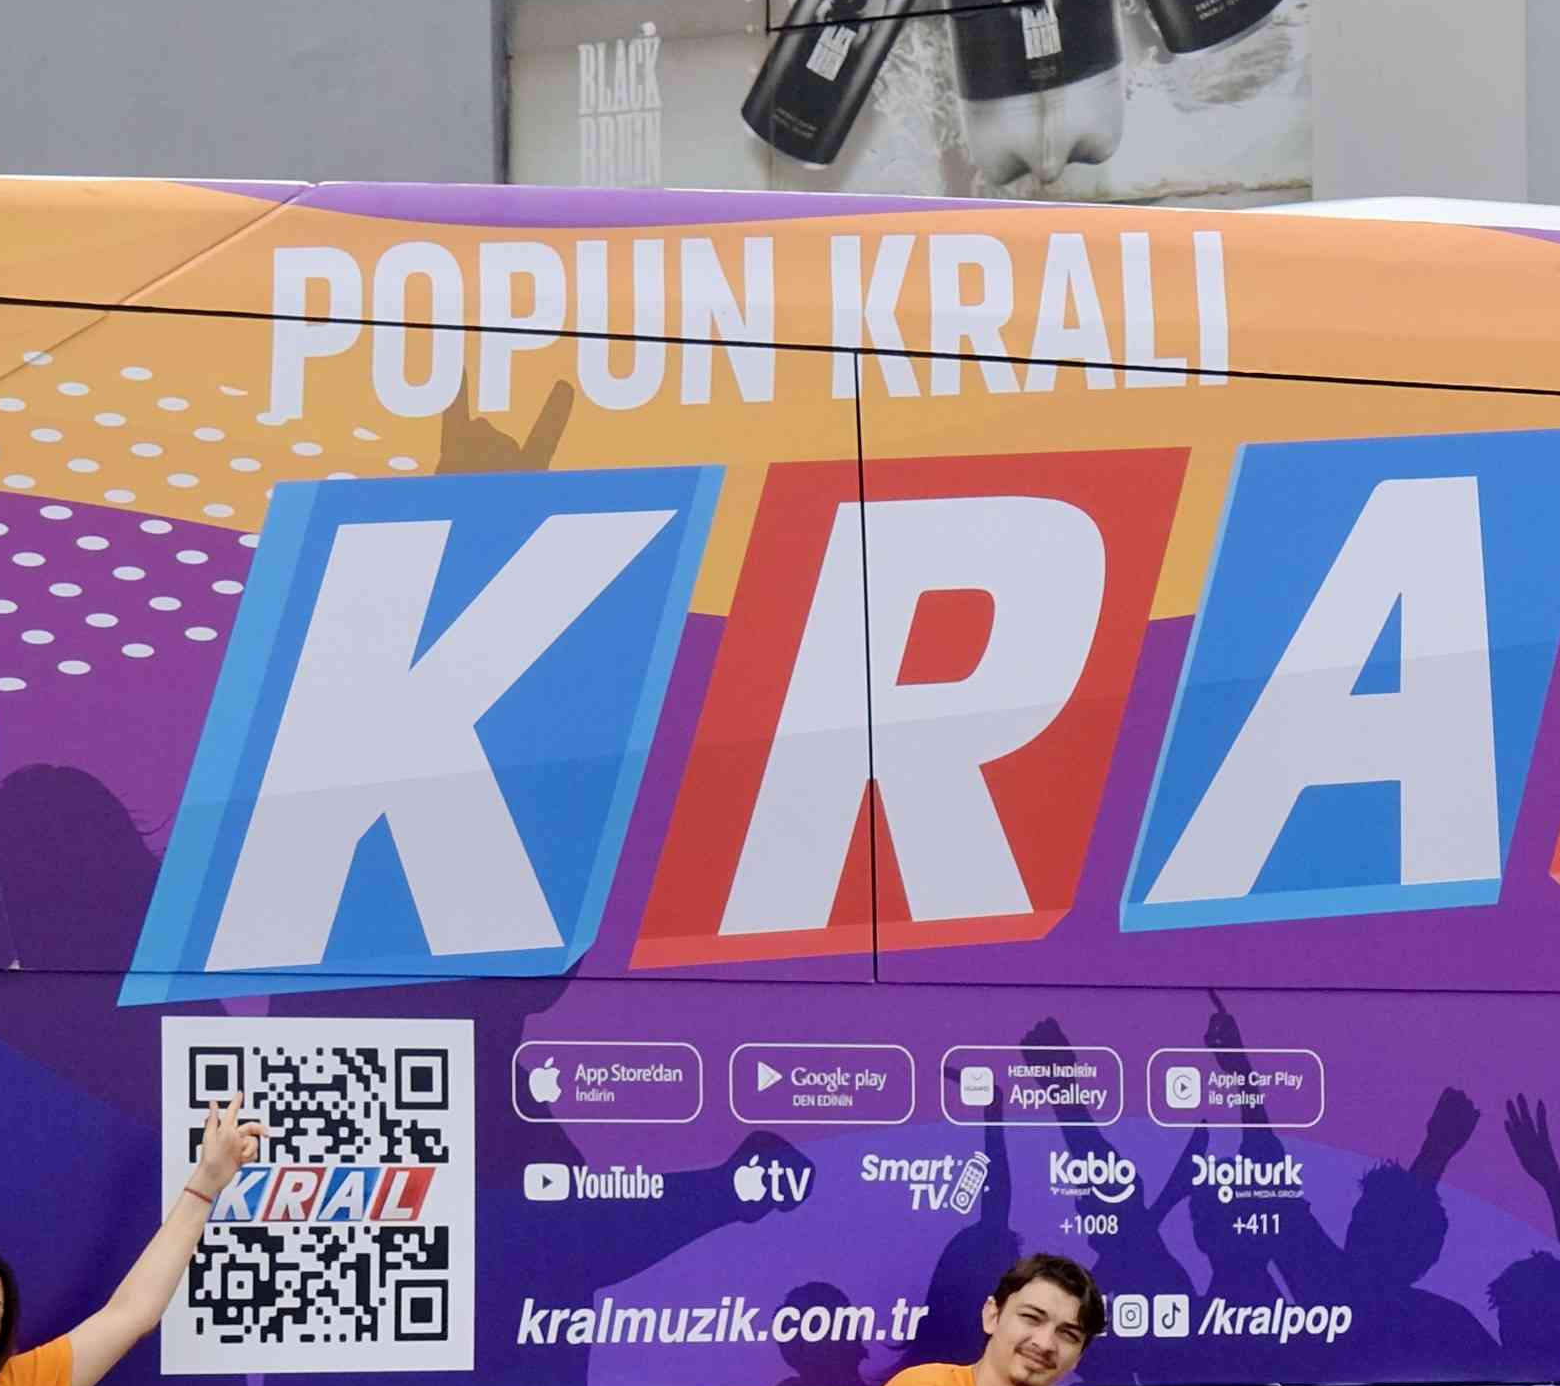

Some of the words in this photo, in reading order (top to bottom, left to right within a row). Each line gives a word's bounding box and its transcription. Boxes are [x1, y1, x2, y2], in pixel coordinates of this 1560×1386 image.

[269, 235, 776, 419] POPUN
[831, 230, 1230, 402] KRALI
[575, 1064, 608, 1086] App
[791, 1067, 851, 1093] Google
[855, 1070, 887, 1091] play
[1008, 1065, 1050, 1078] HEMEN
[1208, 1071, 1246, 1089] Apple
[1248, 1071, 1272, 1087] Car
[1275, 1072, 1303, 1091] Play
[793, 1094, 815, 1107] DEN
[1009, 1083, 1108, 1110] AppGallery
[1208, 1091, 1224, 1106] ile
[768, 1159, 811, 1202] tv
[861, 1154, 954, 1182] Smart
[1050, 1151, 1136, 1186] Kablo
[1192, 1154, 1303, 1204] Digiturk
[214, 1168, 420, 1221] KRAL
[574, 1165, 664, 1200] YouTube
[1060, 1214, 1119, 1235] +1008
[1233, 1214, 1280, 1235] +411
[516, 1298, 929, 1346] kralmuzik.com.tr
[1198, 1295, 1352, 1344] /kralpop
